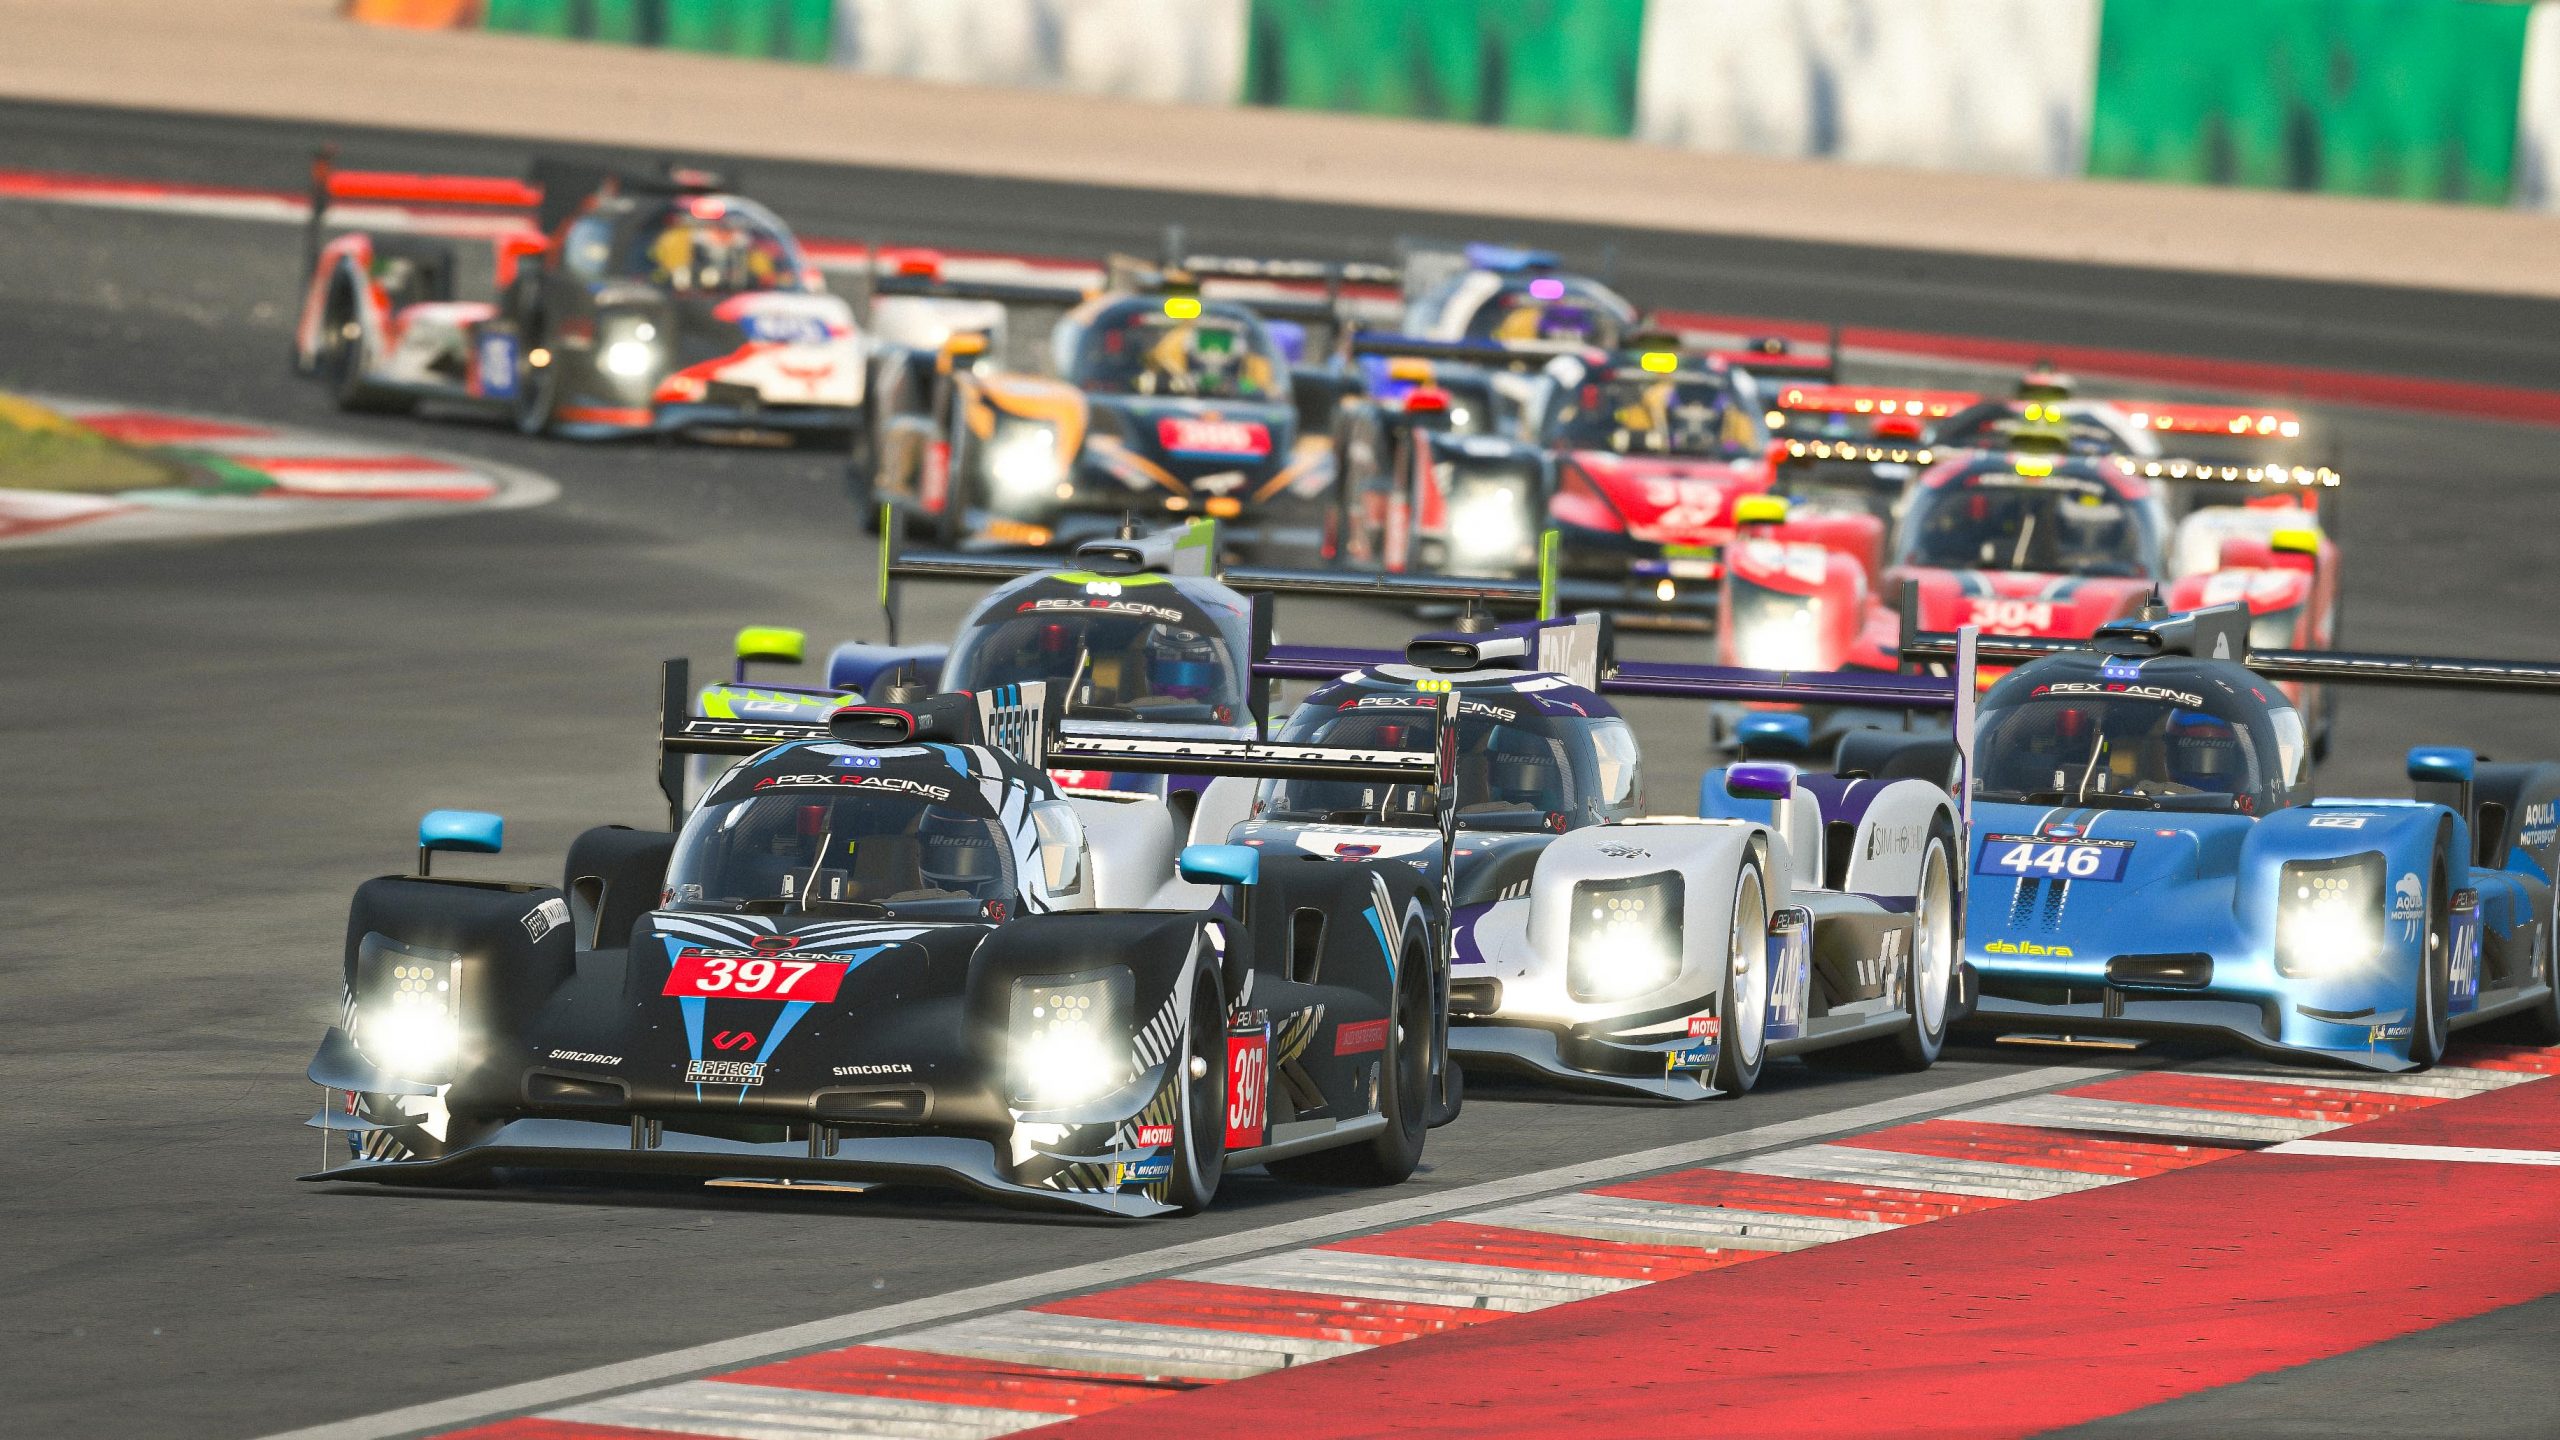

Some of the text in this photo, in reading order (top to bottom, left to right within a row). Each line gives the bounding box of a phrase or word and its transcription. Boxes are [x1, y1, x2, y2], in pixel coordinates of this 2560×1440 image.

[1016, 600, 1085, 613] APEX
[1089, 599, 1183, 622] RACING
[1970, 600, 2051, 630] 304
[2031, 683, 2103, 698] APEX
[2106, 683, 2204, 705] RACING
[1337, 697, 1411, 712] APEX
[1416, 698, 1517, 720] RCING
[754, 775, 835, 790] APEX
[840, 775, 951, 798] RACING
[1989, 834, 2136, 847] APEX RACING
[2000, 843, 2102, 876] 446
[682, 948, 854, 960] APEX RACING
[1985, 939, 2073, 957] dallara
[696, 958, 817, 994] 397
[1230, 1011, 1252, 1027] APEX
[1690, 1020, 1719, 1034] MOTUL
[549, 1049, 623, 1066] SIMCOACH
[1687, 1053, 1716, 1063] MICHELIN
[689, 1060, 767, 1076] EFFECT
[833, 1063, 913, 1076] SIMCOACH
[689, 1074, 760, 1083] SIMULATIONS
[1230, 1048, 1263, 1130] 397
[1140, 1128, 1173, 1144] MOTUL
[1137, 1165, 1169, 1175] MICHELIN
